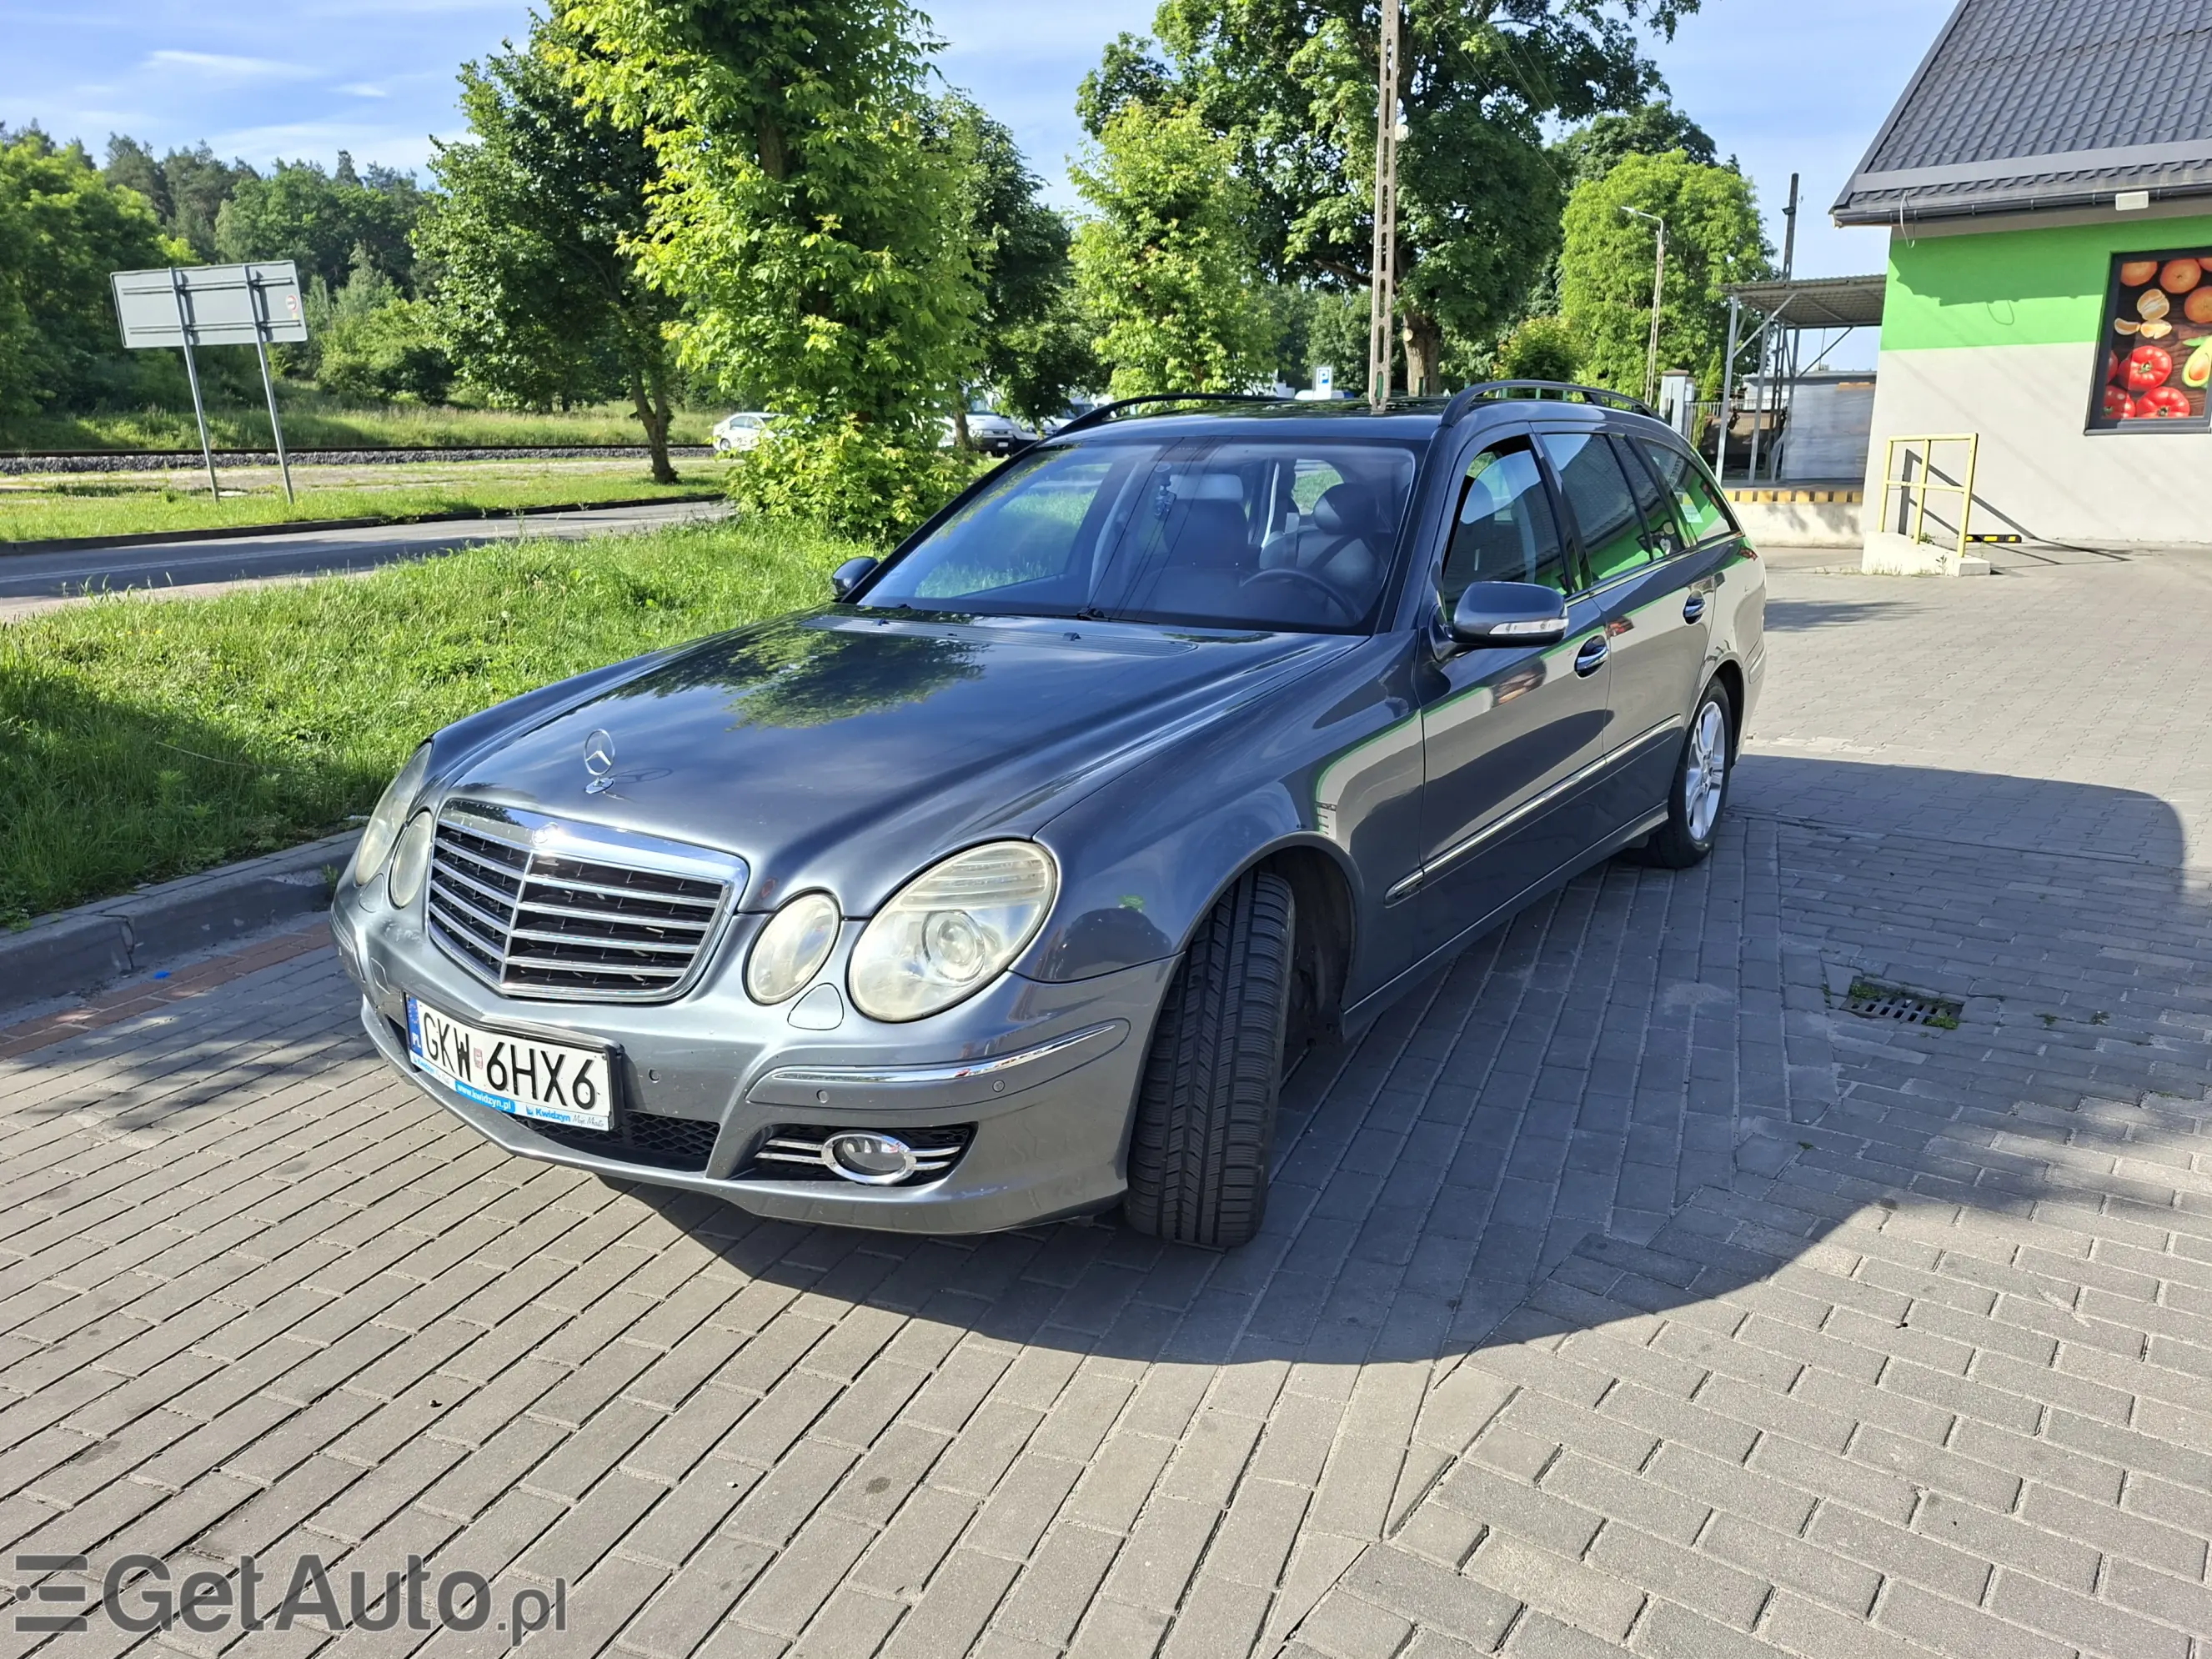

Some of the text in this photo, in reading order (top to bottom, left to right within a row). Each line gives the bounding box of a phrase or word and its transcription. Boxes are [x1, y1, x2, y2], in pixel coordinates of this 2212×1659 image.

[412, 1032, 422, 1048] PL
[424, 1012, 597, 1110] GKW 6HX6
[457, 1083, 512, 1110] www.kwidzyn.pl
[535, 1107, 571, 1122] Kwidzyn
